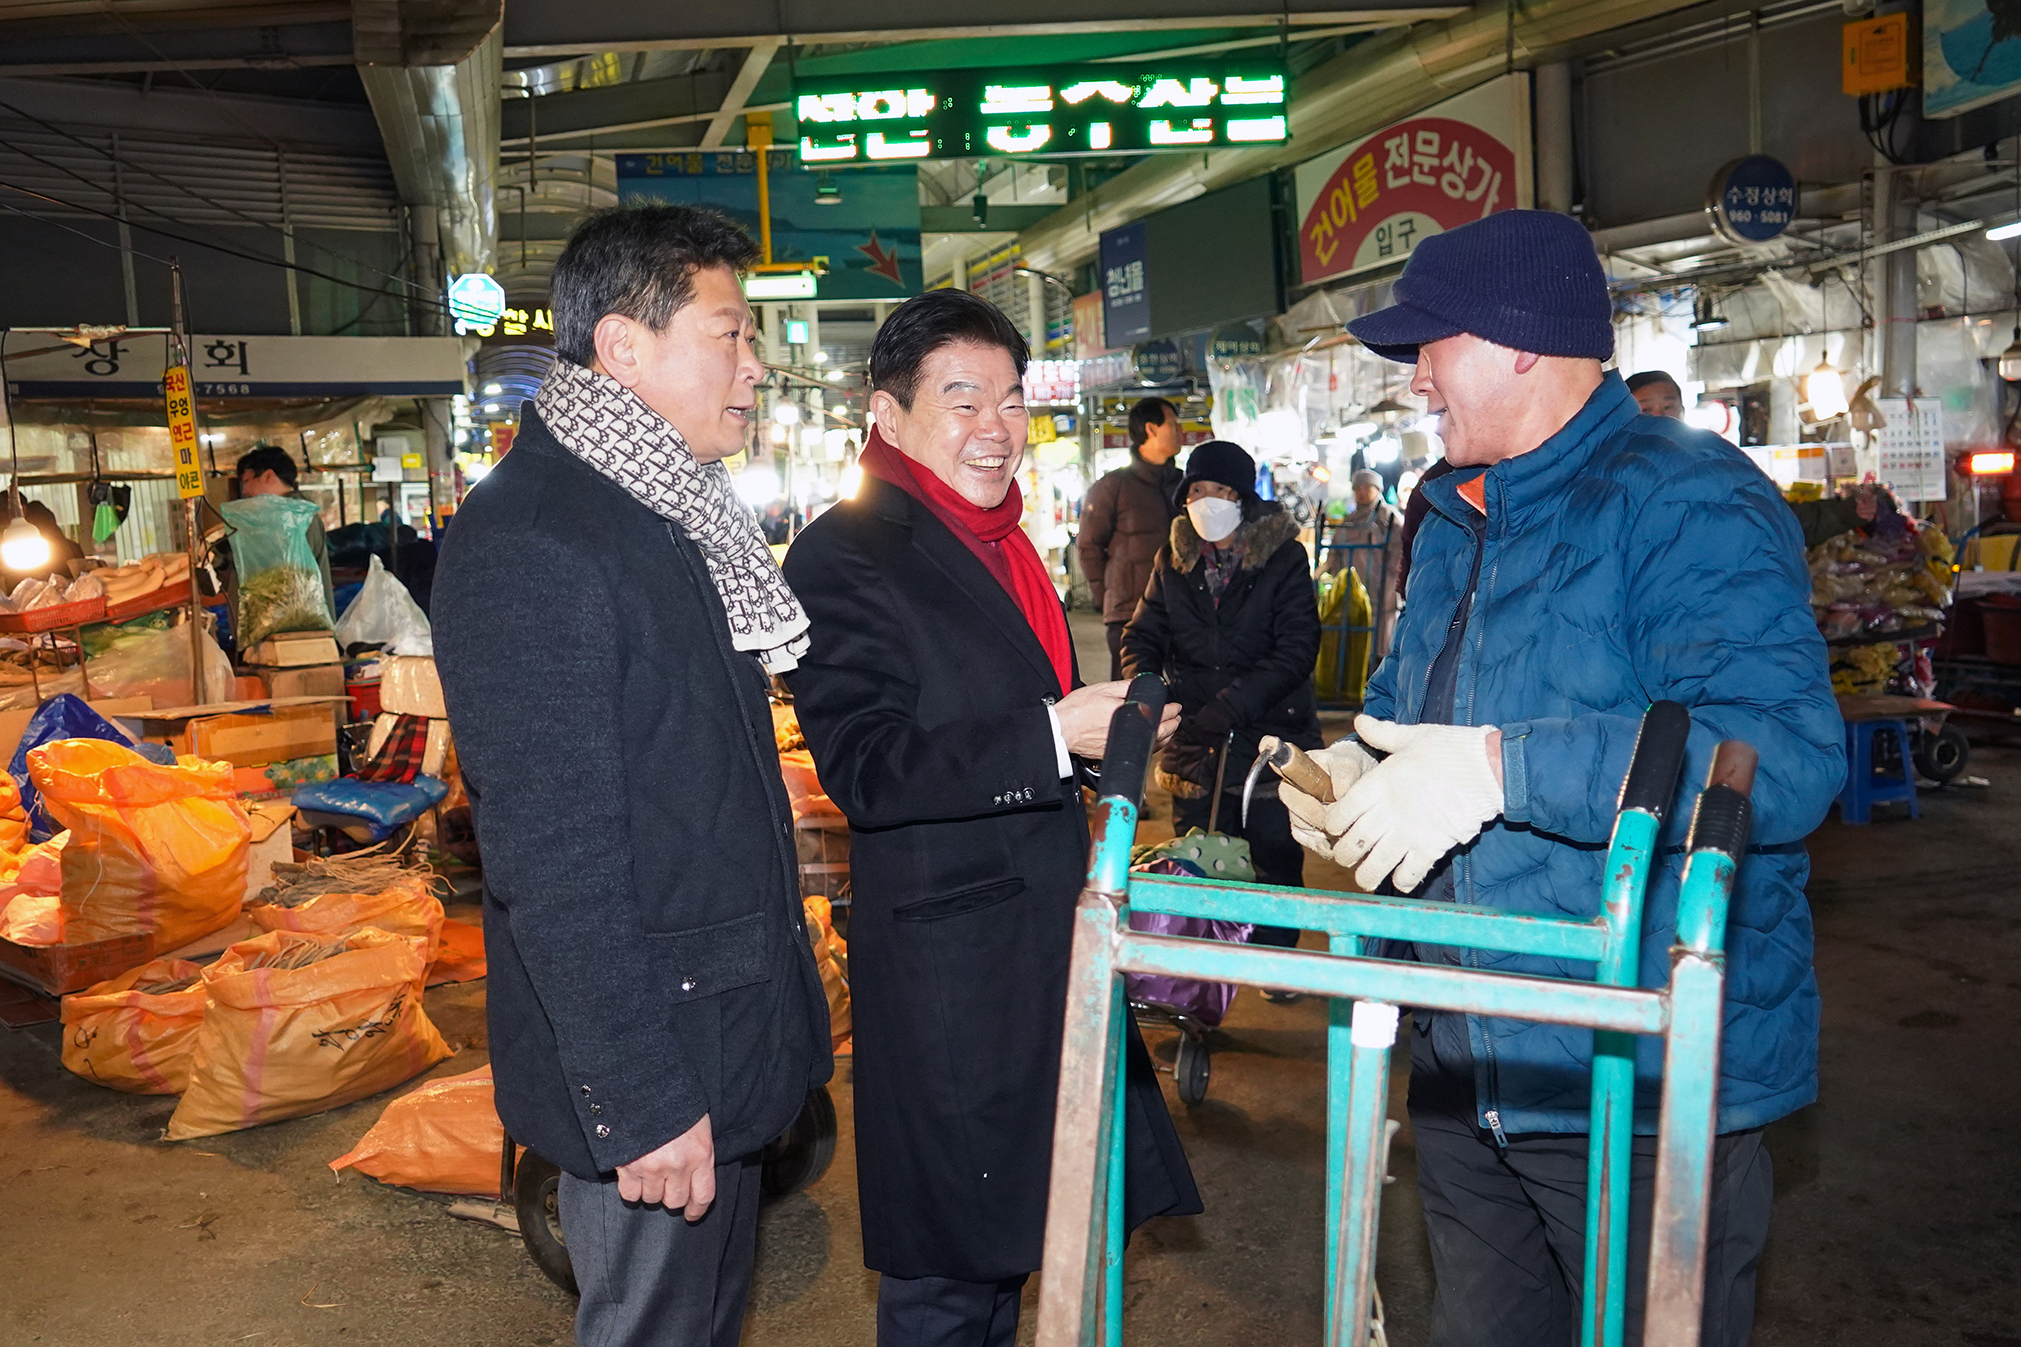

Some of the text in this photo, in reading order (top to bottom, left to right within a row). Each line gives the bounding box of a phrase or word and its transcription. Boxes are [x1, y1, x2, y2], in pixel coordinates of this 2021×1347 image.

[646, 154, 703, 175] 건어물
[1310, 130, 1502, 267] 건어물 전문상가
[1726, 186, 1793, 206] 수정상회
[1376, 218, 1417, 257] 입구
[166, 373, 185, 393] 국산
[169, 397, 189, 418] 우엉
[172, 422, 193, 443] 연근
[180, 447, 192, 465] 마
